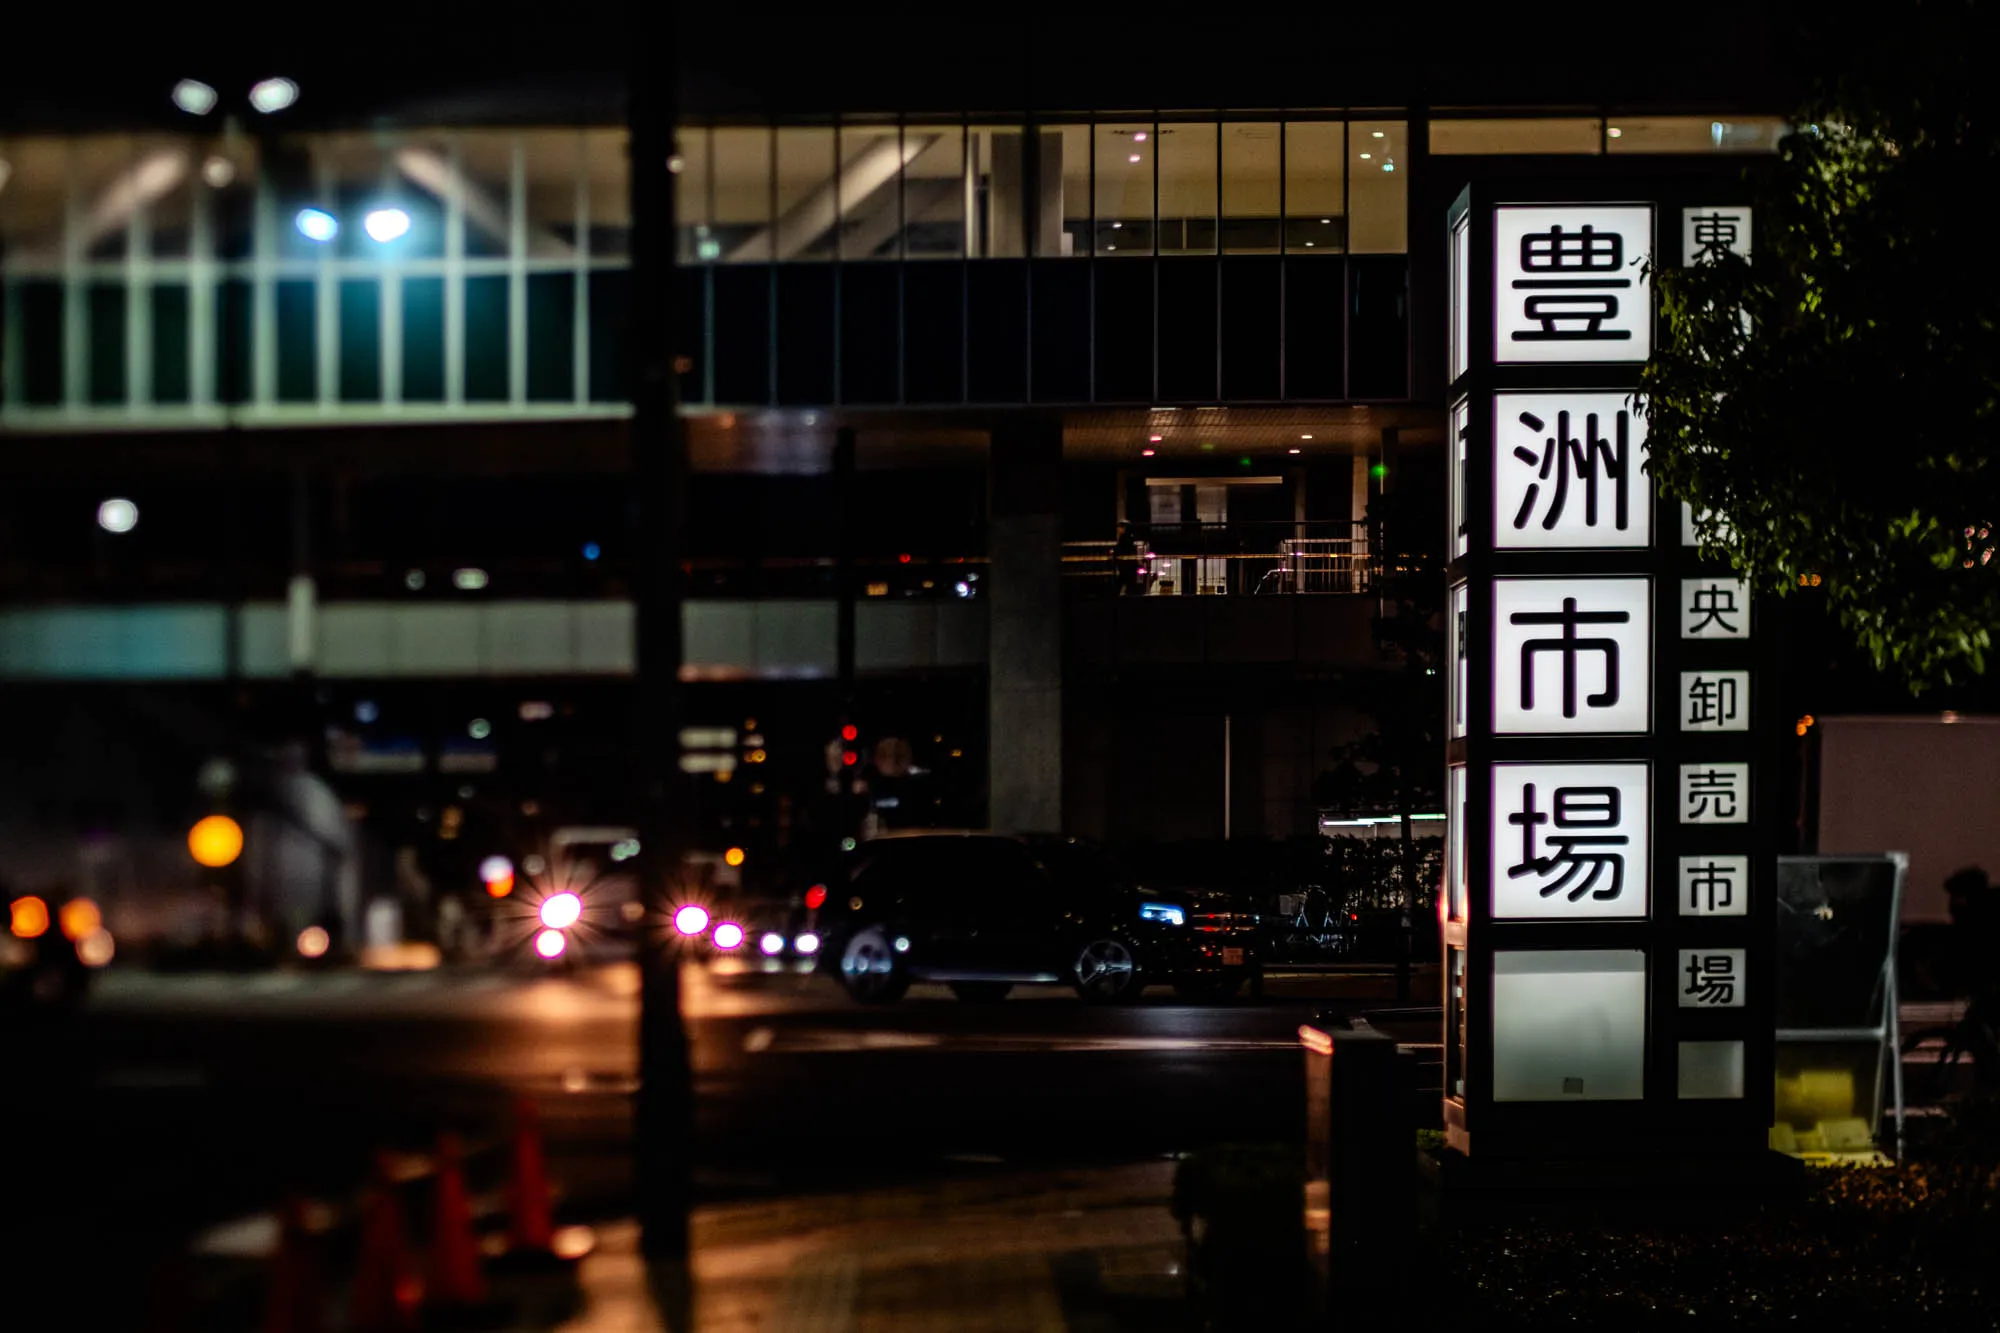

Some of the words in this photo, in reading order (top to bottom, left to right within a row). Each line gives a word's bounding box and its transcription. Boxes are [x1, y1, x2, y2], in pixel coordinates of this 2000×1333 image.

[1507, 224, 1632, 902] 豊洲市場
[1685, 212, 1740, 1004] 東央卸売市場
